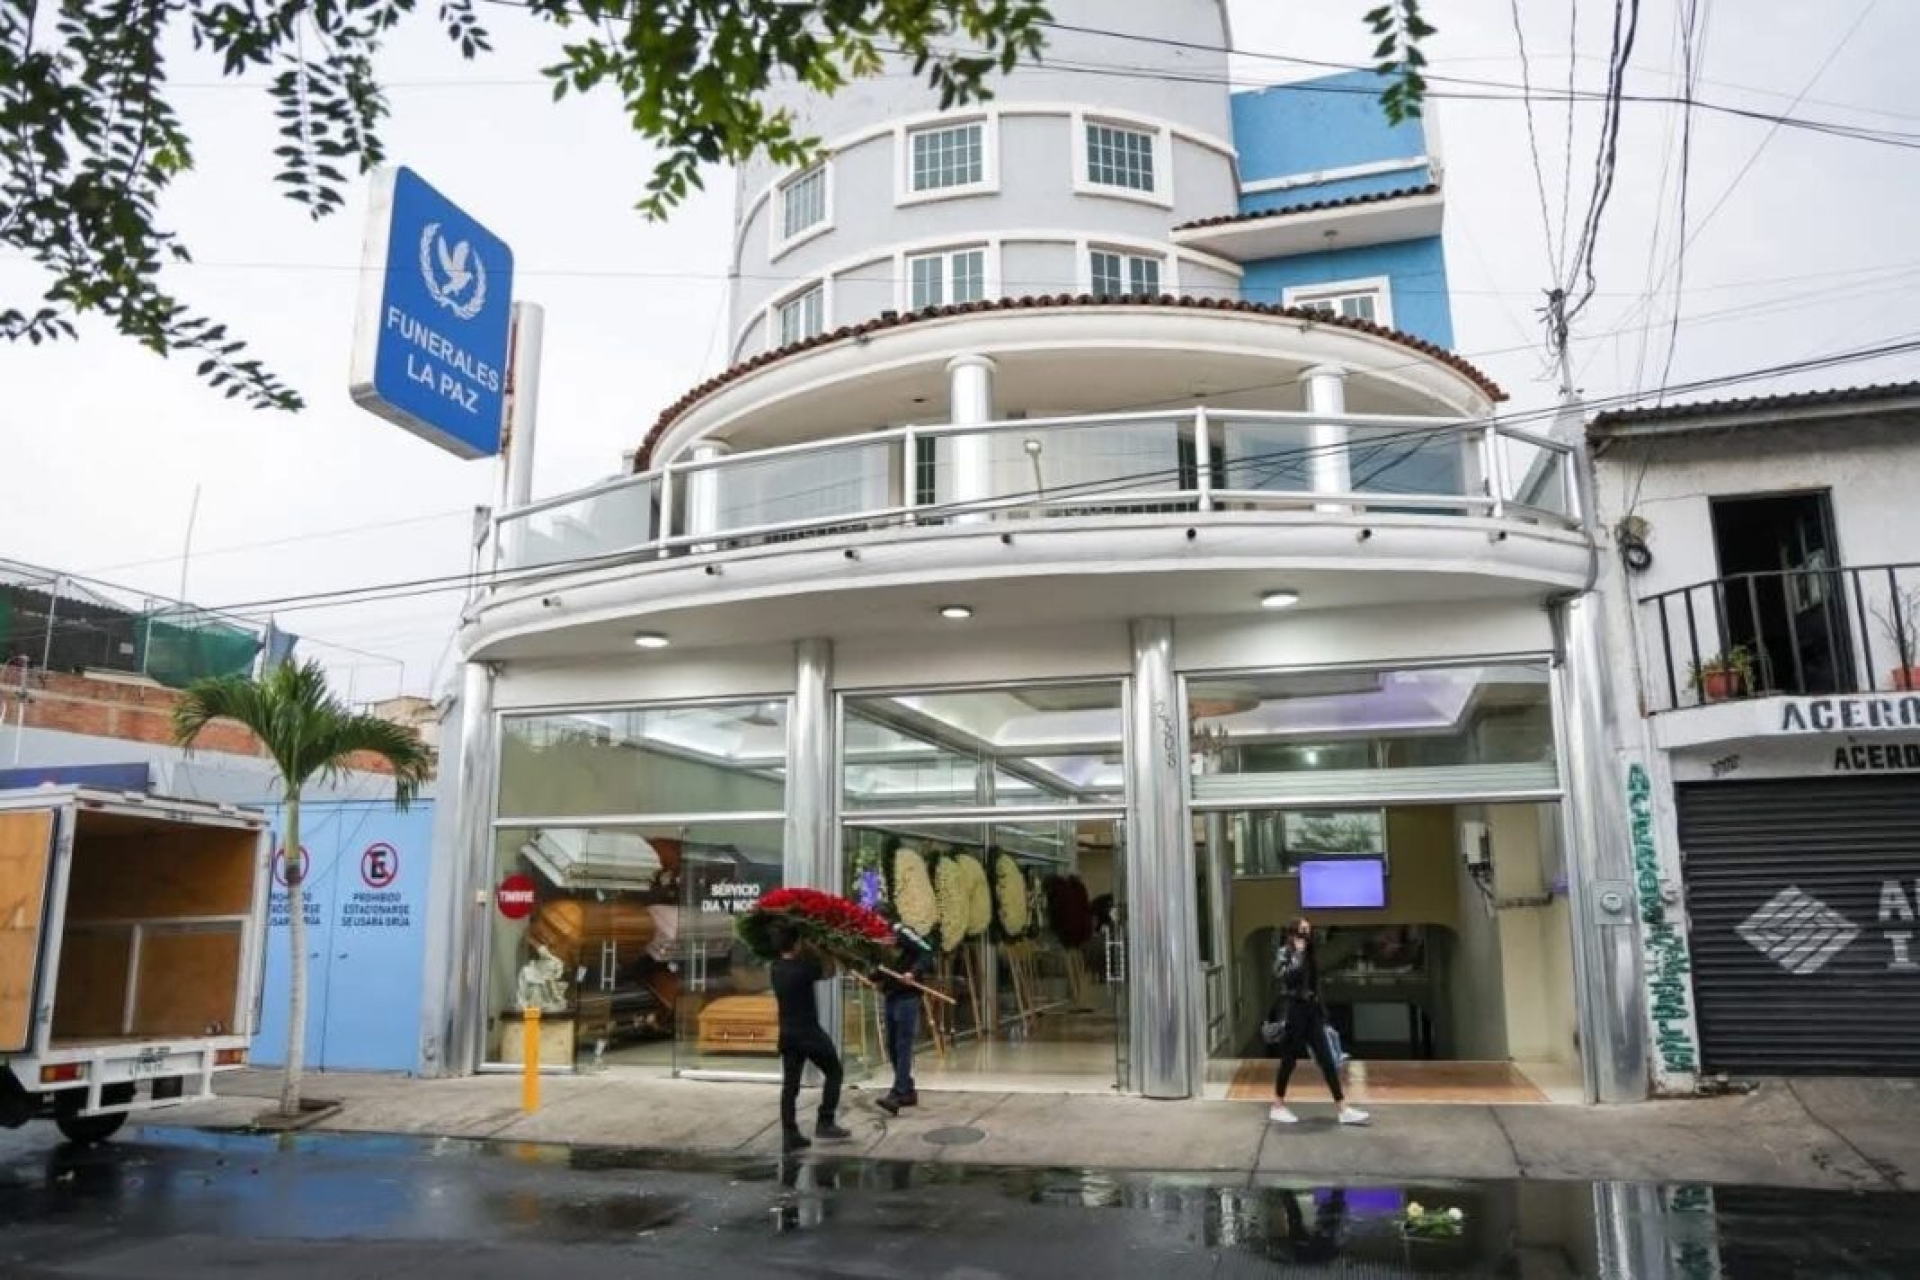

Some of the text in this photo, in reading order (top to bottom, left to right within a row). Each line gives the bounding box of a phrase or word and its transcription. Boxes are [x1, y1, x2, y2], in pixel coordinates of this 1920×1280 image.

[387, 305, 499, 392] FUNERALES
[407, 353, 479, 414] LA PAZ
